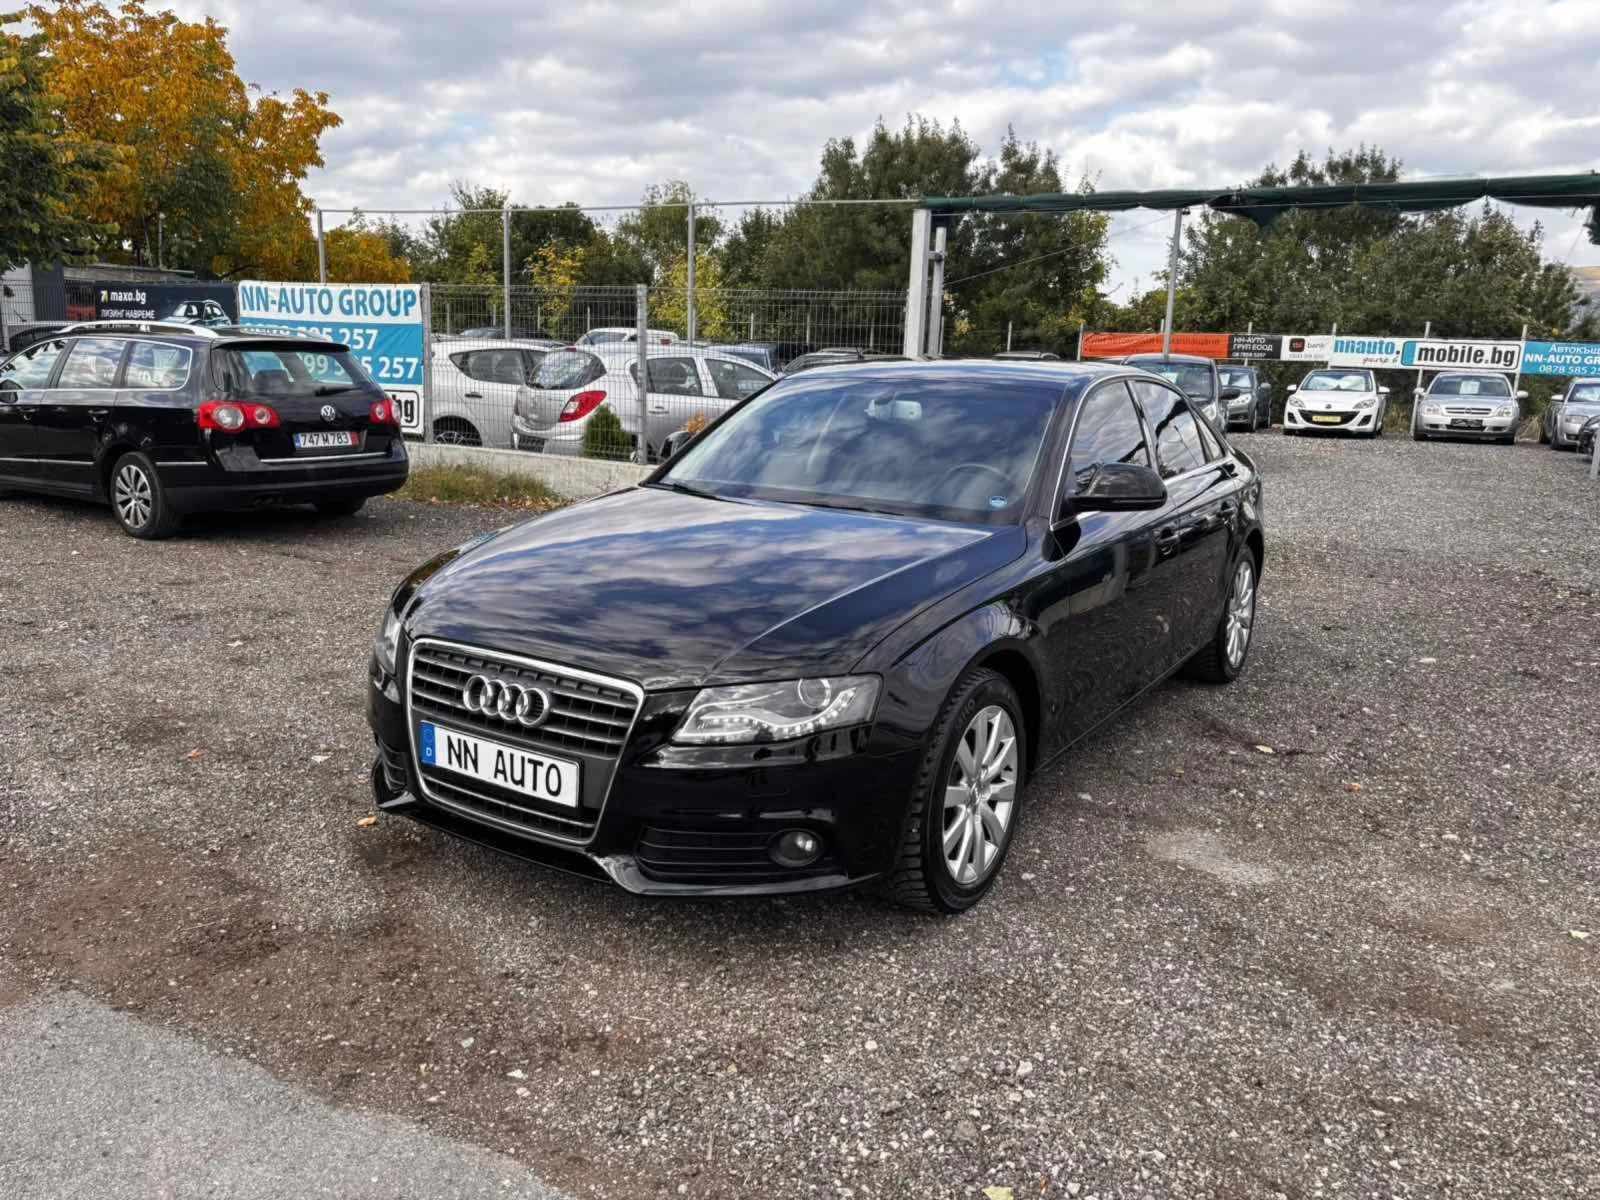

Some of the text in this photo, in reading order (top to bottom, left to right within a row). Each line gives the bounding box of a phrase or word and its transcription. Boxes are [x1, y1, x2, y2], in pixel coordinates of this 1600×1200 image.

[110, 289, 146, 304] maxo.bg
[241, 286, 417, 317] NN-AUTO GROUP
[125, 310, 155, 319] НАВРЕМЕ
[339, 328, 378, 350] 257
[1418, 346, 1515, 367] mobile.bg
[1524, 353, 1582, 364] NN-AUTO
[379, 357, 418, 379] 257
[1539, 364, 1565, 373] 0878
[1568, 365, 1588, 374] 585
[447, 735, 562, 797] NN AUTO
